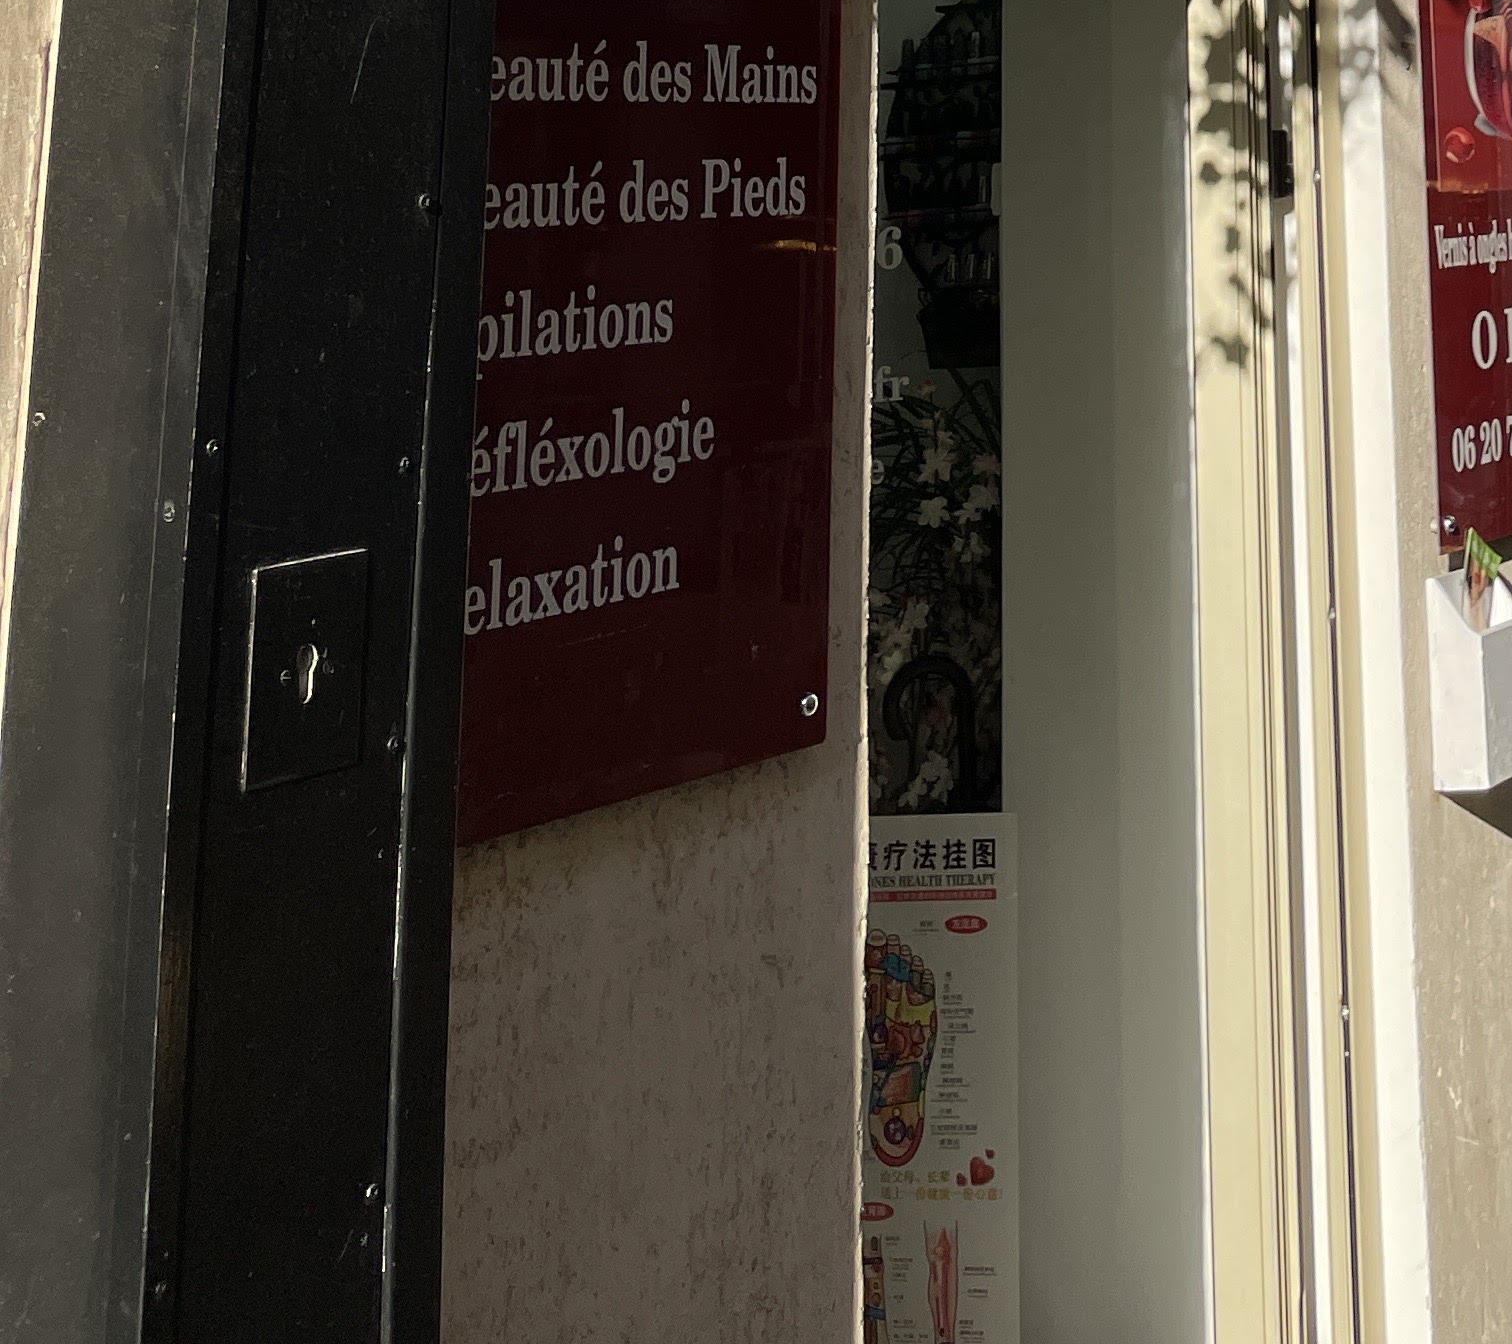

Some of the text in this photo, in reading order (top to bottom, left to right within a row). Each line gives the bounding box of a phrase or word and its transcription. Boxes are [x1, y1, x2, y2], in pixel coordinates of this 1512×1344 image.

[488, 40, 818, 105] eauté des Mains
[483, 157, 806, 232] eauté des Pieds
[1434, 222, 1468, 269] Vernis
[476, 284, 674, 381] pilations
[469, 398, 715, 498] éfléxologie
[1452, 424, 1476, 473] 06
[1480, 418, 1503, 465] 20
[463, 535, 679, 636] elaxation
[898, 873, 943, 888] HEALTH
[945, 872, 997, 887] THERAPY
